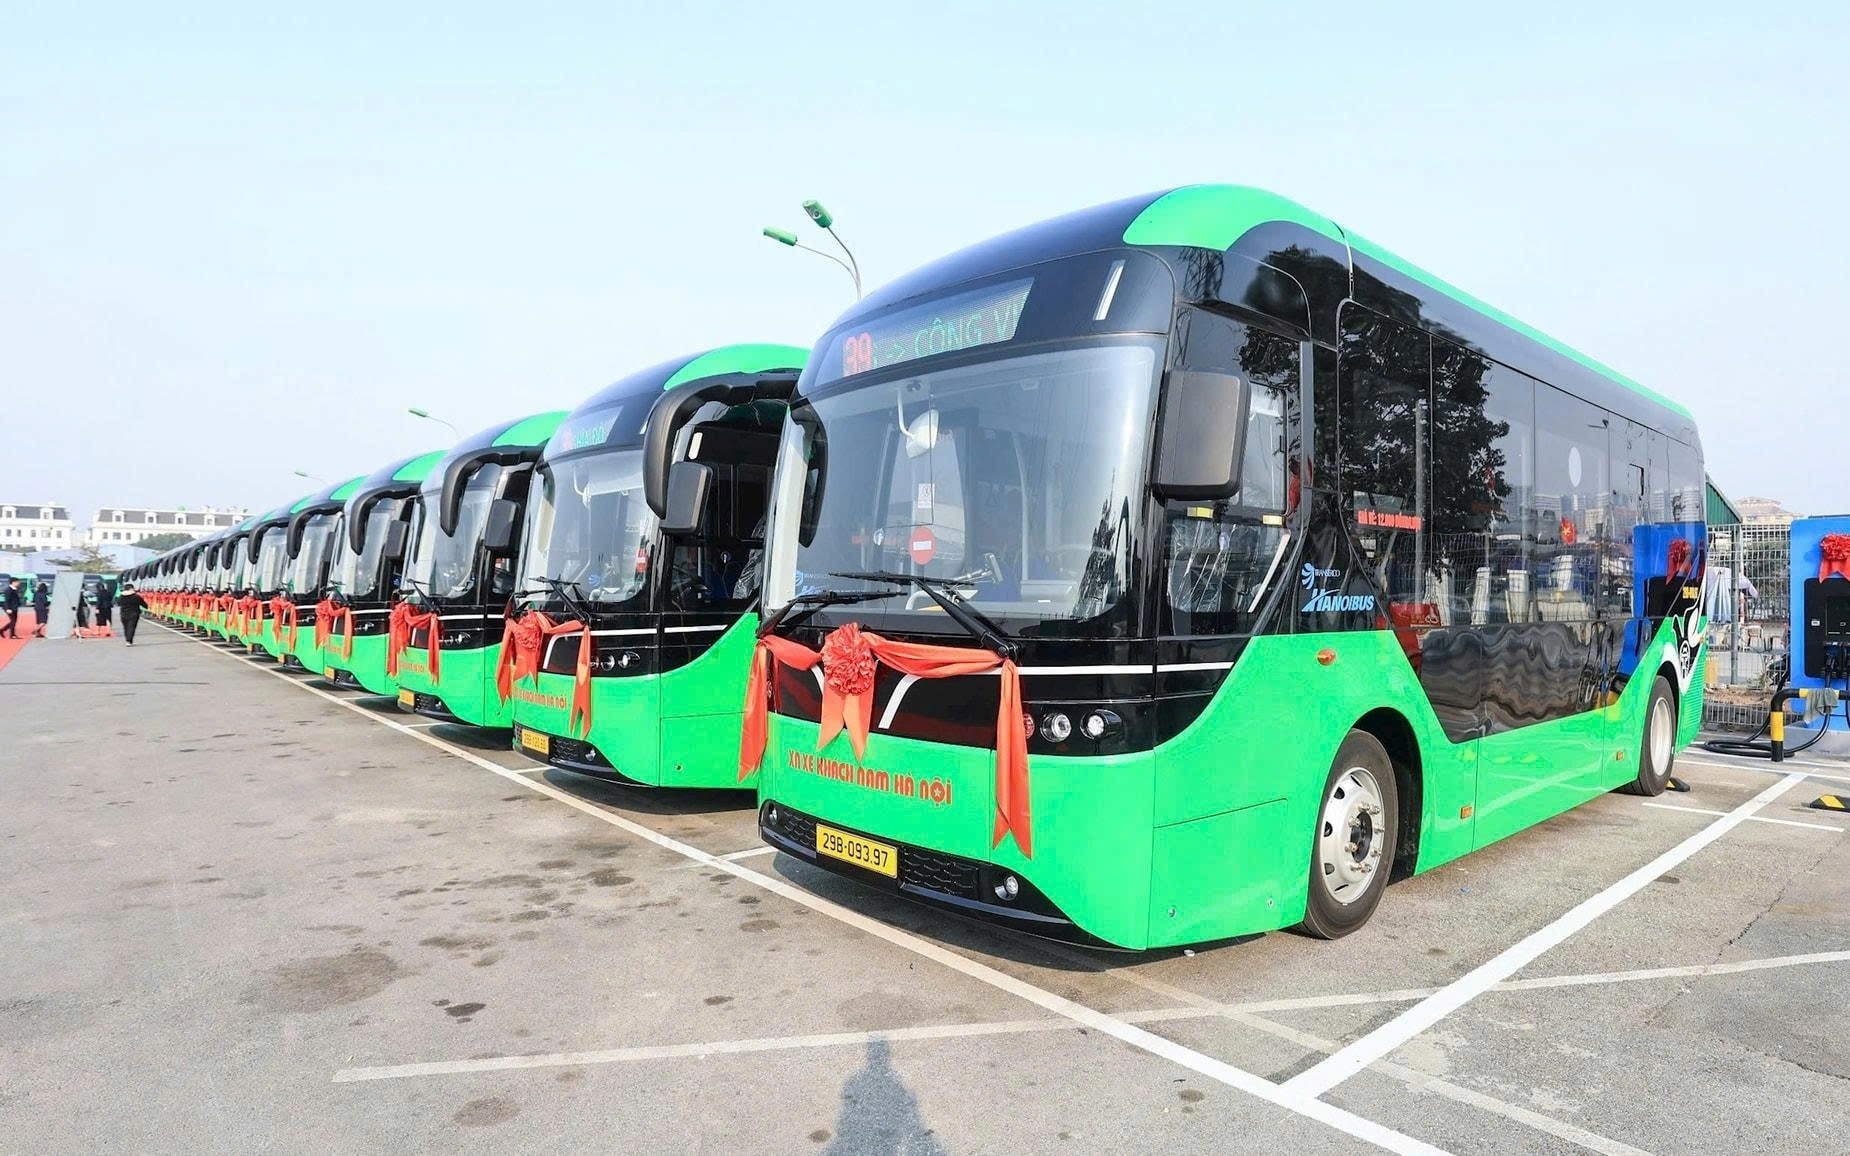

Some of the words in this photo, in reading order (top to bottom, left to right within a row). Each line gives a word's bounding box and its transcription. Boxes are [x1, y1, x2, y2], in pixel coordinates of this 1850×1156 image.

[914, 313, 982, 358] CÔNG
[802, 753, 814, 772] XE
[816, 756, 853, 783] KHÁCH
[857, 767, 890, 792] NAM
[894, 771, 915, 797] HÀ
[919, 777, 953, 807] NỘI
[823, 832, 888, 868] 29B-093.97
